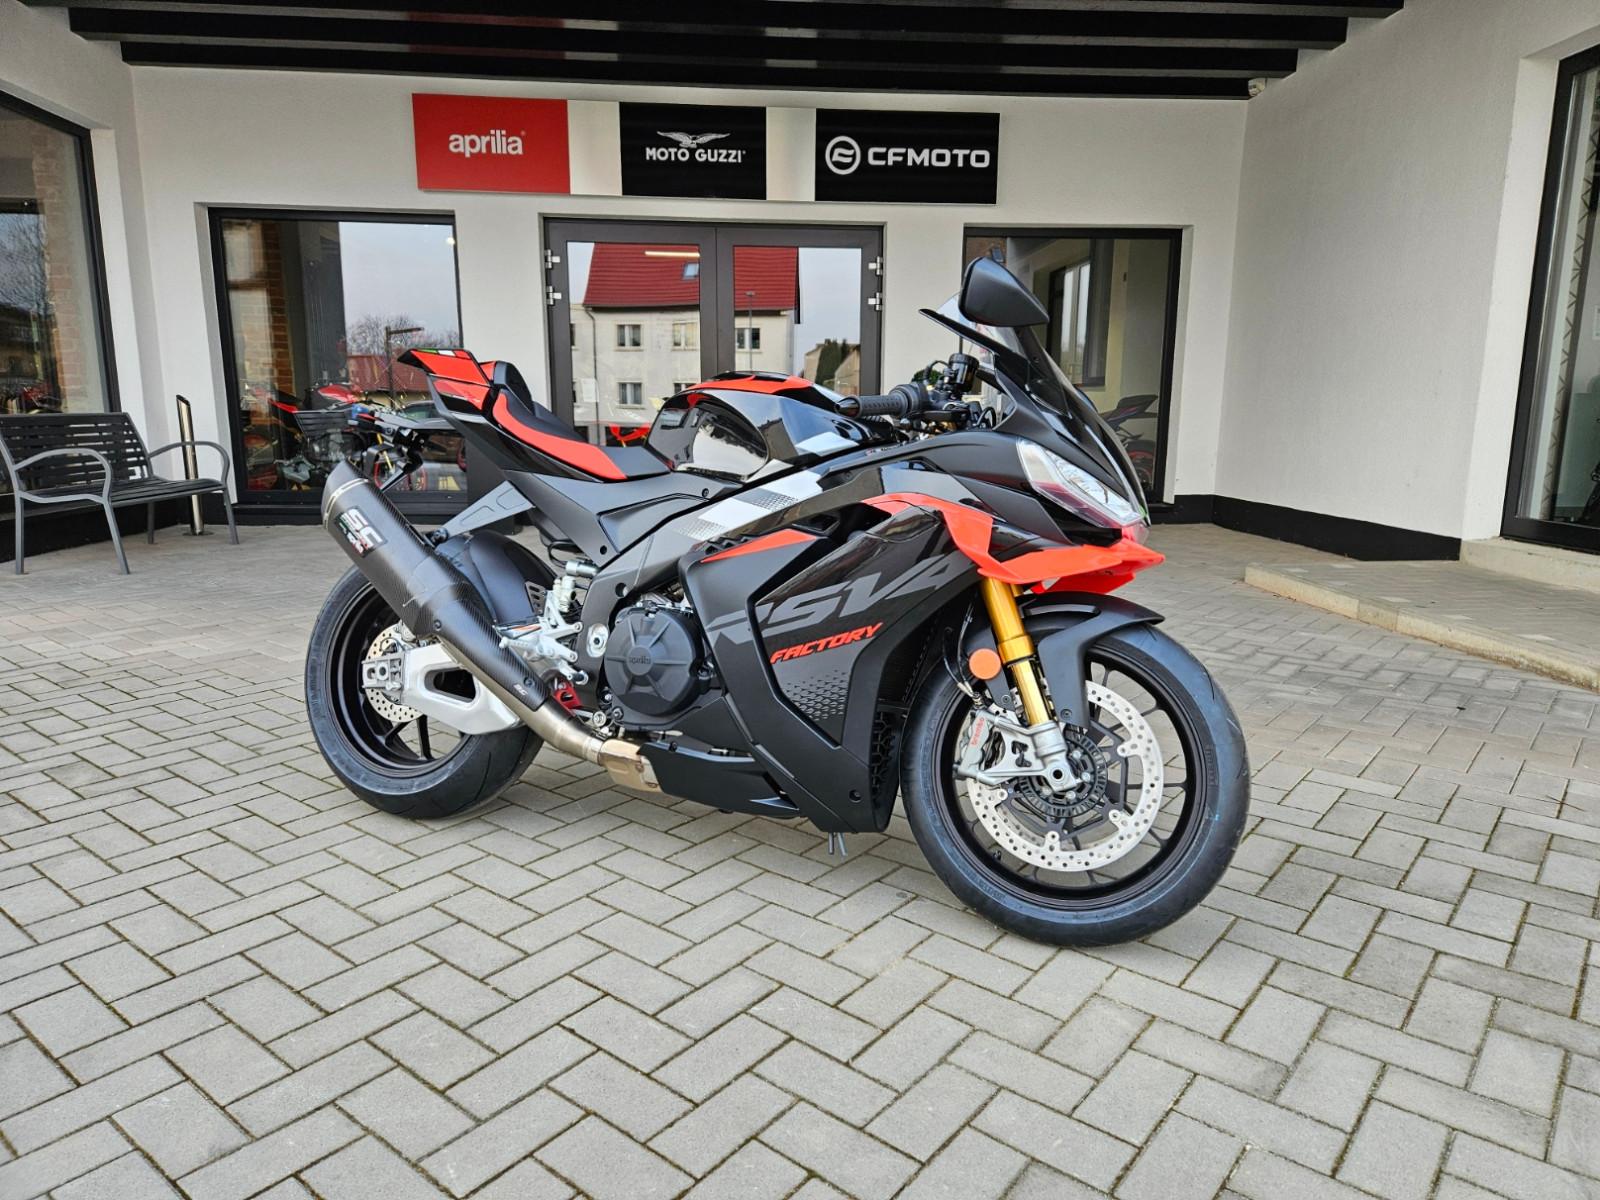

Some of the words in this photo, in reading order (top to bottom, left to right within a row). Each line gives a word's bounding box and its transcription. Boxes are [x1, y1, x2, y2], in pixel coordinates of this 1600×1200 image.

[448, 129, 523, 157] aprilia
[645, 147, 690, 161] MOTO
[695, 149, 742, 163] GUZZI
[867, 147, 991, 168] CFMOTO
[770, 621, 883, 665] FACTORY
